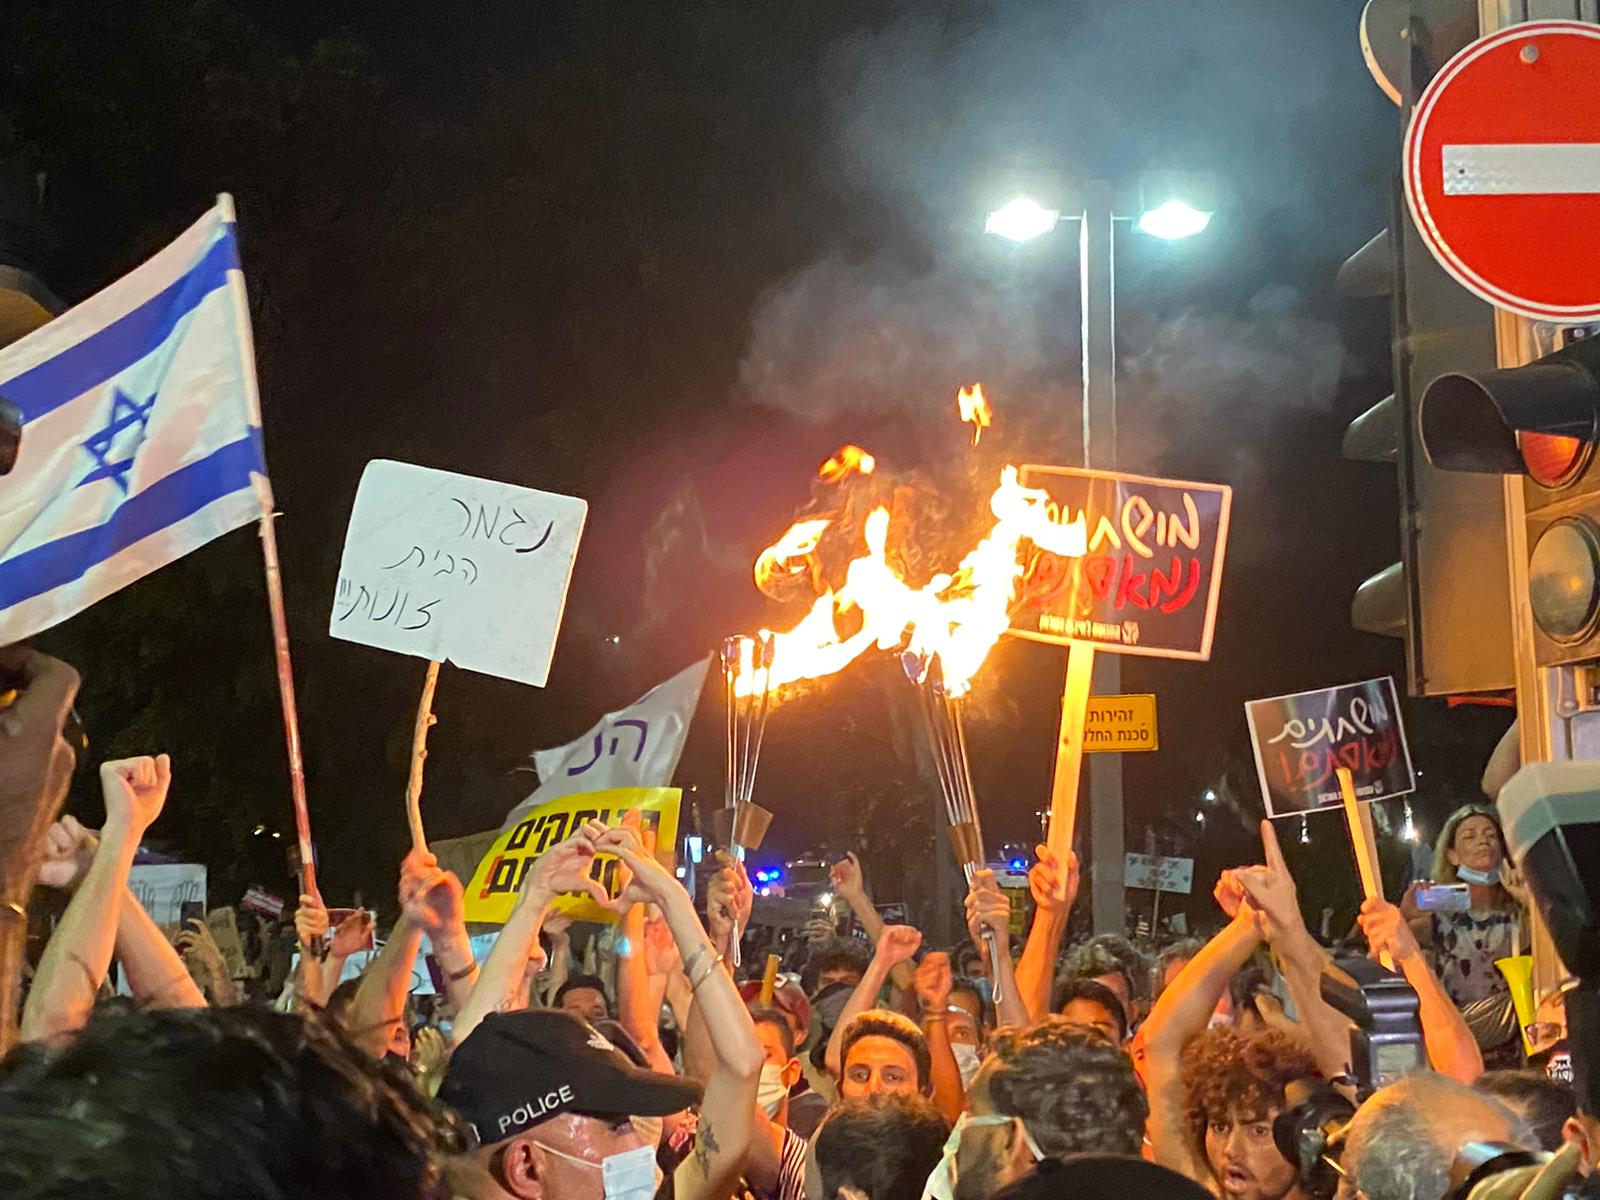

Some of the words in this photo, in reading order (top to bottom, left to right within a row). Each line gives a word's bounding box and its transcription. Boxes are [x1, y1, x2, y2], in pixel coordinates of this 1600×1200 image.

[450, 497, 554, 553] נגמר
[381, 545, 478, 584] הבית
[1089, 709, 1134, 723] זהירות
[1117, 729, 1150, 742] סכנת
[498, 1084, 575, 1134] POLICE
